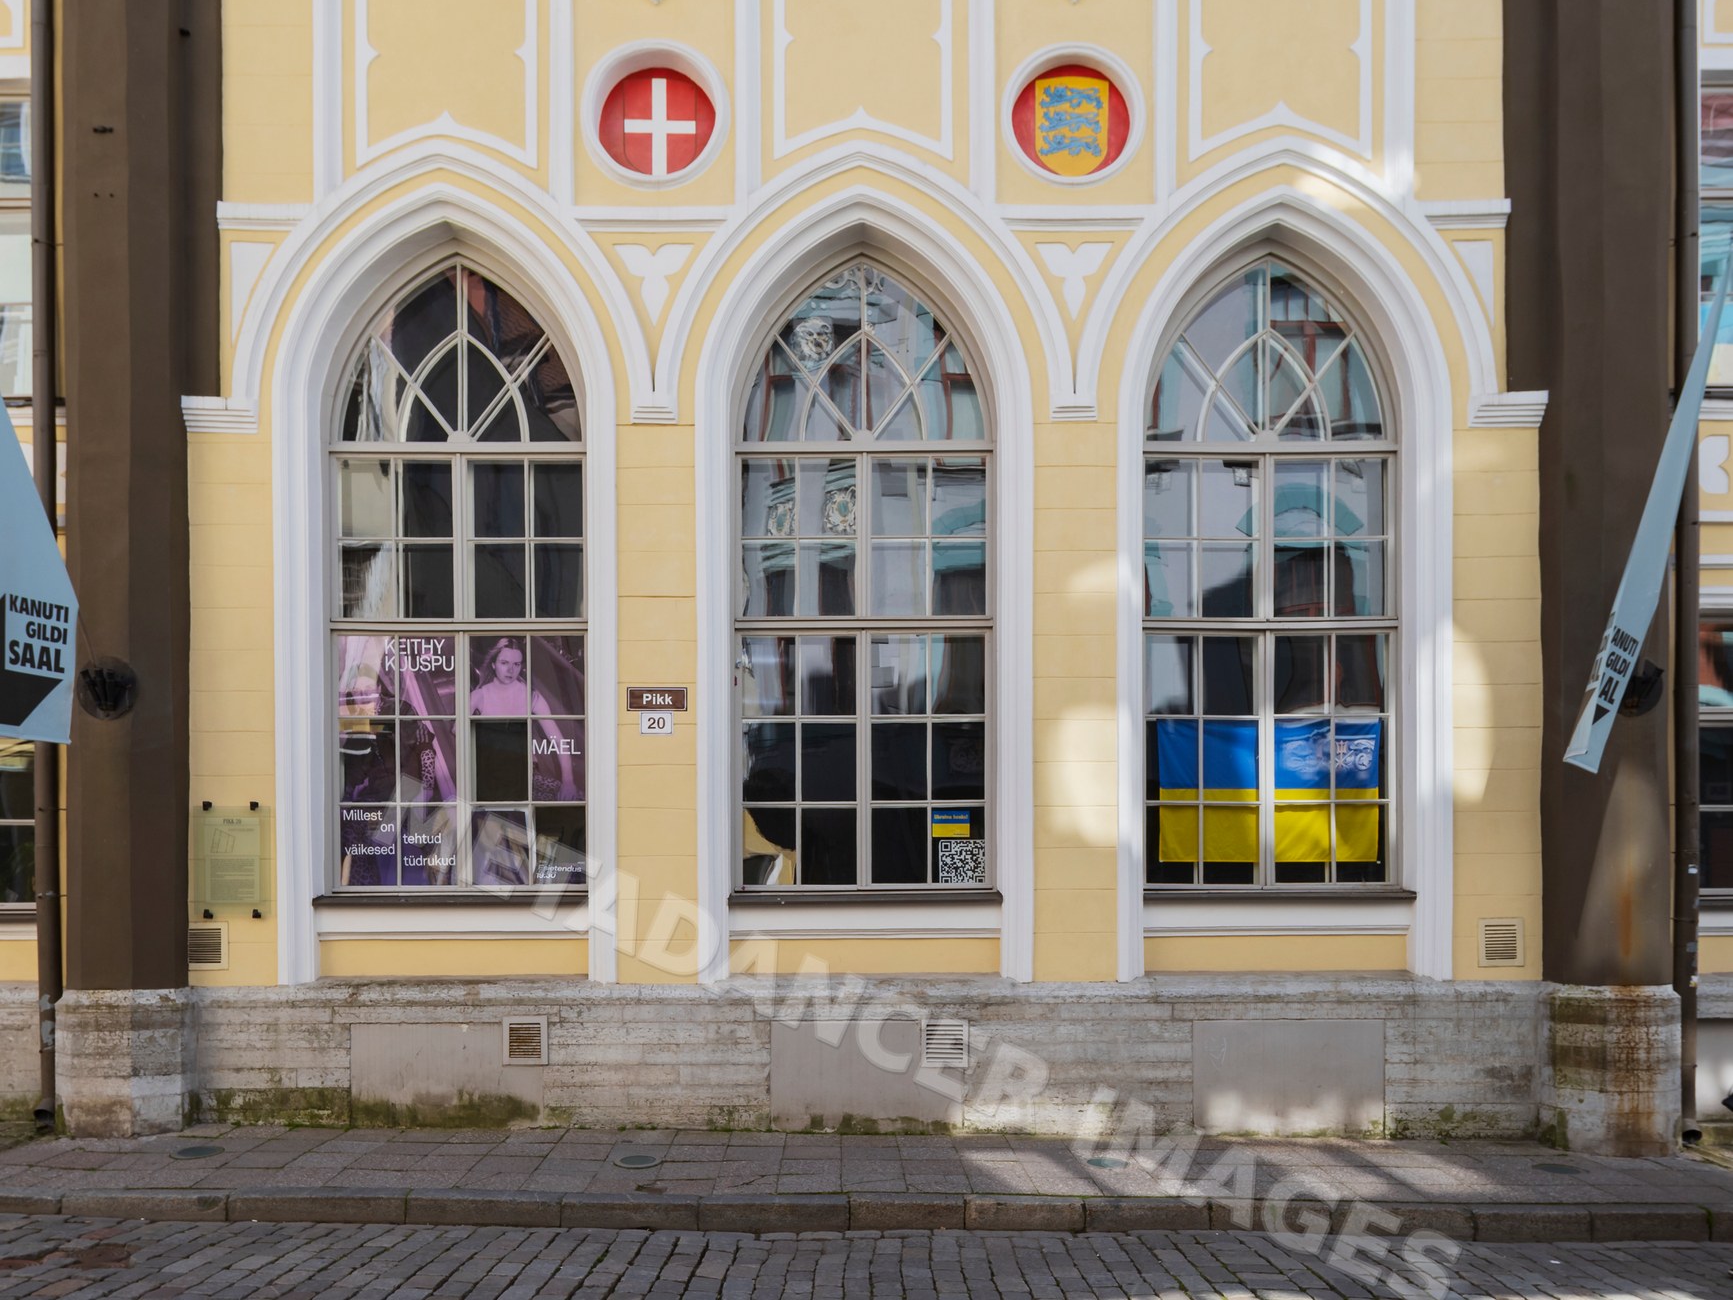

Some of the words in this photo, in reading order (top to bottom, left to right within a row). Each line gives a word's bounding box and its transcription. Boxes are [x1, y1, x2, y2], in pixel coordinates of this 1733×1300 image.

[9, 593, 69, 623] KANUTI
[26, 620, 68, 645] GILDI
[385, 638, 446, 655] KEITHY
[8, 639, 65, 674] SAAL
[385, 655, 455, 672] KUUSPU
[1605, 651, 1631, 678] GILDI
[643, 694, 672, 705] Pikk
[647, 717, 666, 730] 20
[532, 736, 581, 755] MÄEL
[342, 809, 383, 821] Millest
[380, 823, 395, 832] on
[403, 833, 442, 845] tehtud
[345, 844, 395, 856] väikesed
[403, 854, 456, 867] tüdrukud
